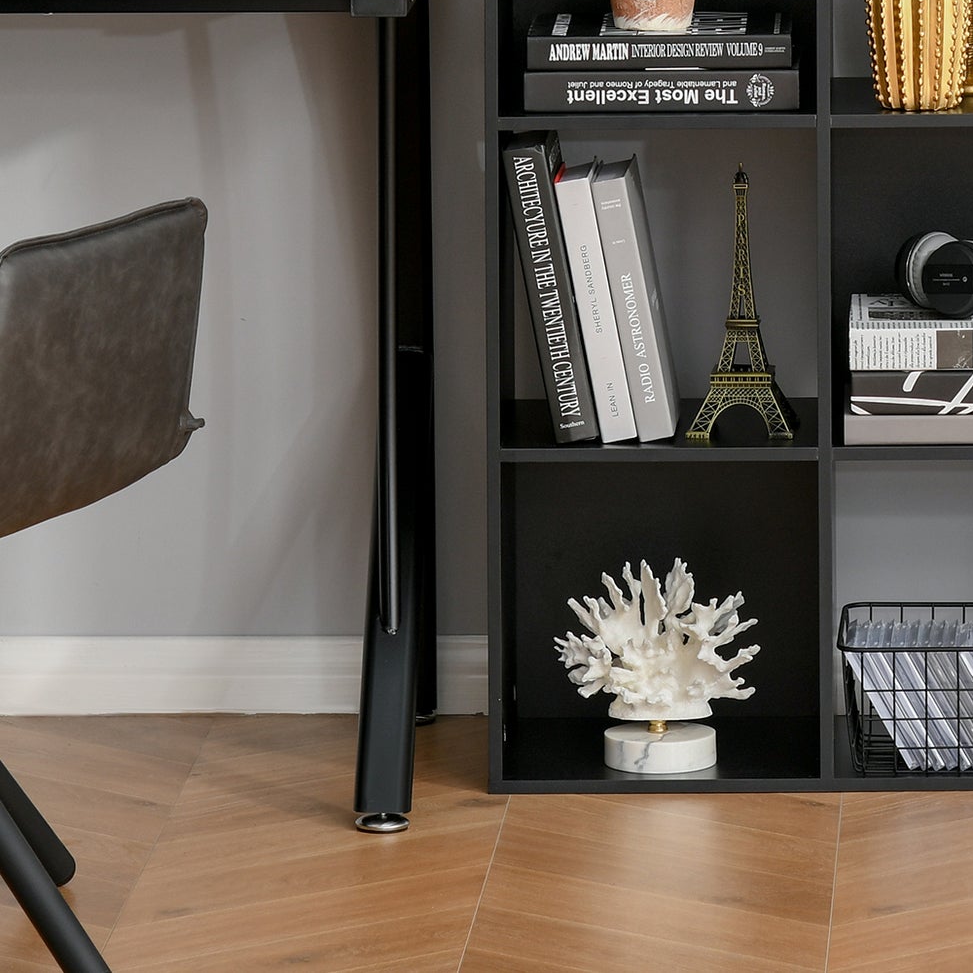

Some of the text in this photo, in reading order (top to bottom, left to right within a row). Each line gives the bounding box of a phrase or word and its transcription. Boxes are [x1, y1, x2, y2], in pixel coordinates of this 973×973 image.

[549, 44, 590, 61] ANDREW
[592, 43, 629, 60] MARTIN
[631, 44, 666, 58] INTERIOR
[667, 43, 694, 57] DESIGN
[695, 43, 724, 57] REVIEW
[726, 42, 758, 56] VOLUME
[758, 42, 763, 56] 9
[567, 79, 737, 89] and Lamentable Tragedy of Romeo and Juliet
[567, 89, 649, 105] Excellent
[655, 89, 699, 104] Most
[704, 89, 738, 104] The
[531, 248, 553, 264] IN
[534, 263, 557, 290] THE
[580, 244, 603, 334] SHERYL SANDBERG
[539, 289, 570, 361] TWENTIETH
[620, 272, 656, 403] RADIO ASTRONOMER
[552, 360, 582, 417] CENTURY
[606, 382, 619, 418] LEAN IN
